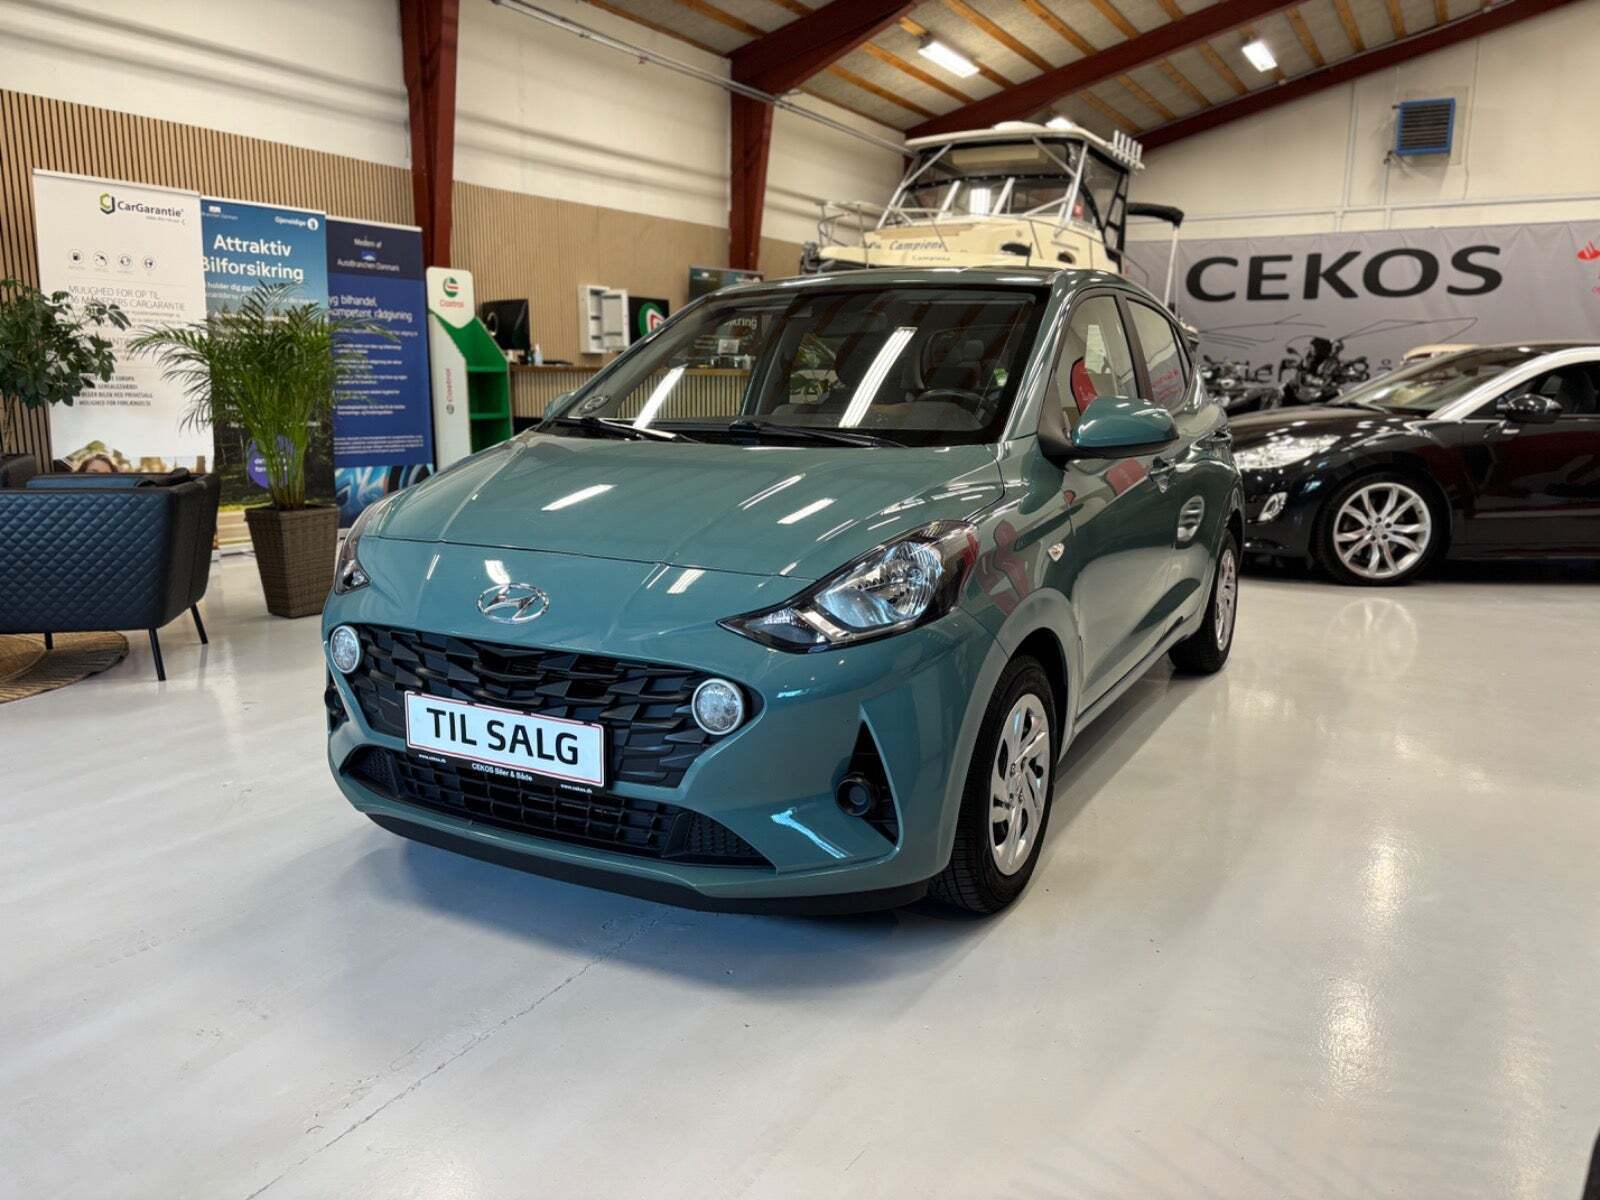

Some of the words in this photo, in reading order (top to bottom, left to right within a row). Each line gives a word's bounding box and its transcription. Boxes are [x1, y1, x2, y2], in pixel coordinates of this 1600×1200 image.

[117, 201, 182, 217] CarGarantie
[213, 233, 292, 257] Attraktiv
[202, 255, 304, 284] Bilforsikring
[1185, 244, 1503, 303] CEKOS
[116, 287, 132, 297] FOR
[135, 289, 147, 298] OP
[426, 707, 477, 746] TIL
[487, 719, 578, 765] SALG
[472, 762, 494, 774] CEKOS
[510, 769, 516, 778] &
